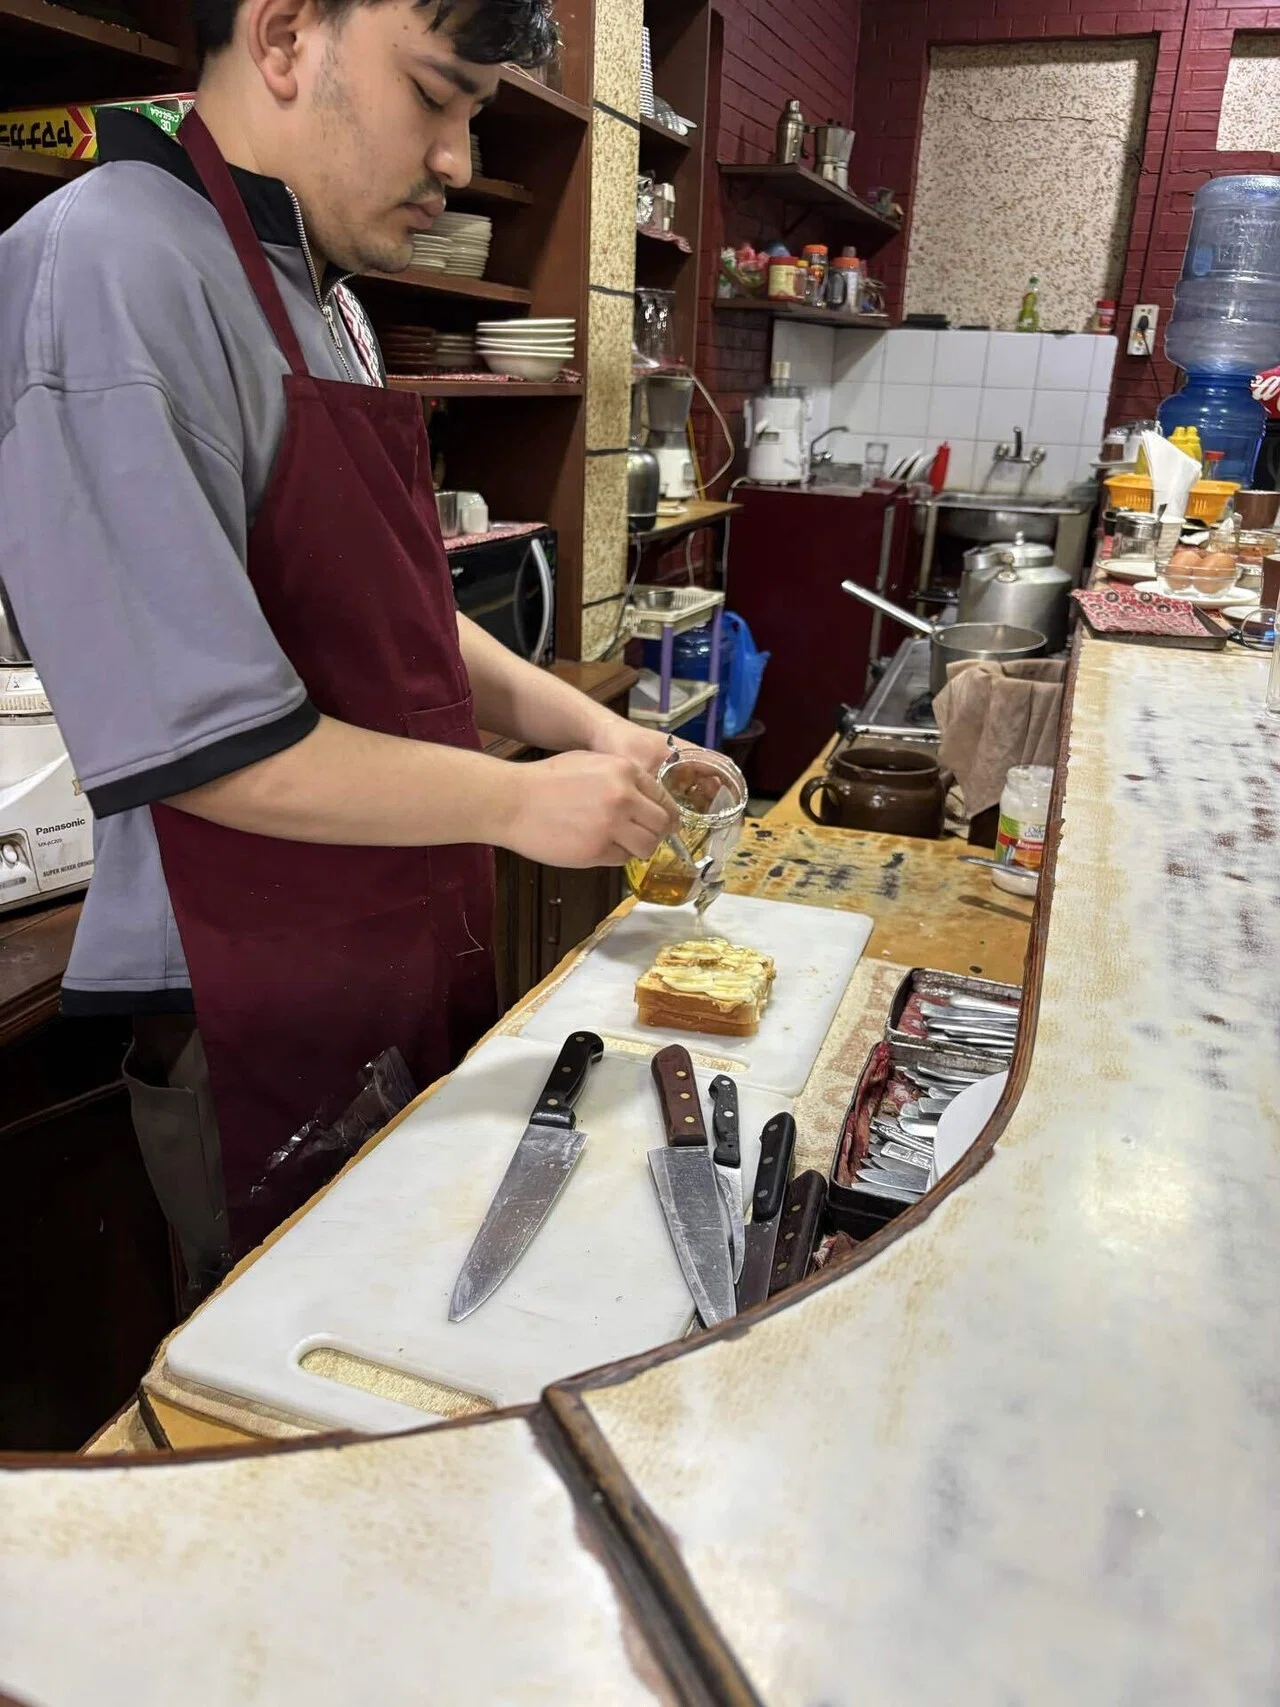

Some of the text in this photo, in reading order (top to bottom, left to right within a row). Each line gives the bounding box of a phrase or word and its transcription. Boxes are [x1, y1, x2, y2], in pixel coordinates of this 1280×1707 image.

[160, 119, 171, 133] 30
[36, 818, 86, 835] Panasonic
[43, 868, 60, 877] SUPER
[60, 864, 76, 873] MIXER
